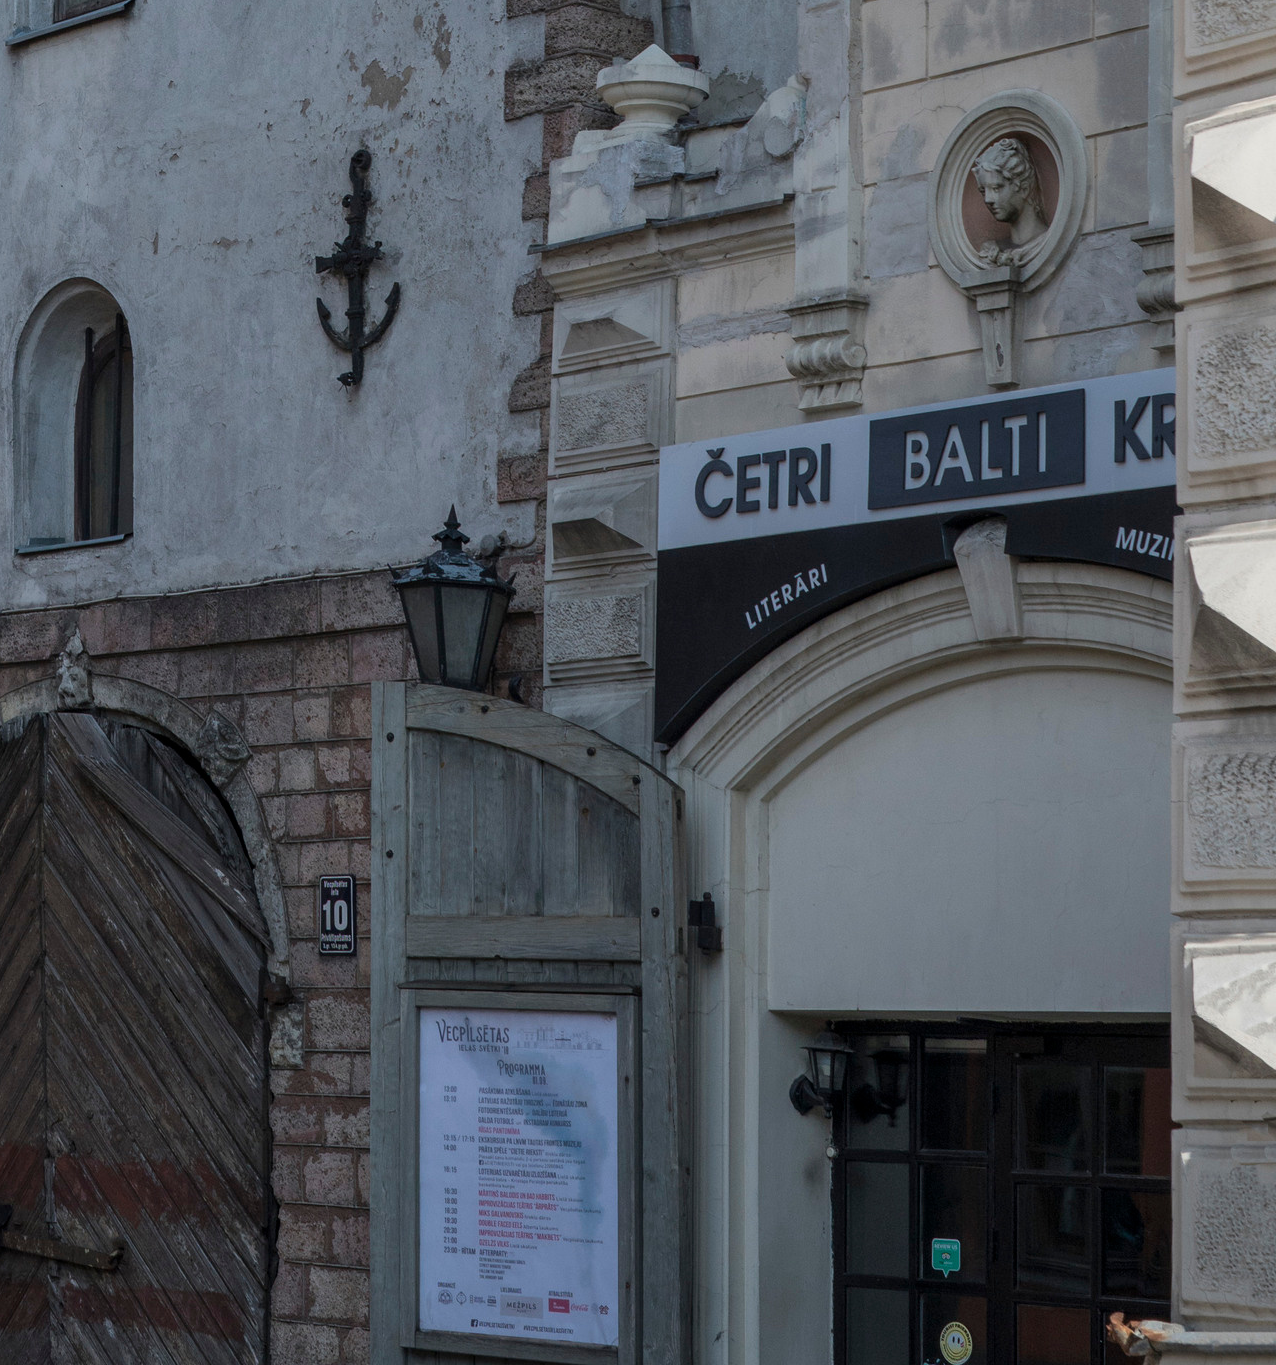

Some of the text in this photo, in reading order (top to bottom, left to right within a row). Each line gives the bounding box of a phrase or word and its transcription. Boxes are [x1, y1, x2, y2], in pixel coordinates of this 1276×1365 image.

[694, 443, 831, 519] ČETRI
[904, 411, 1048, 491] BALTI
[744, 563, 829, 630] LITERĀRI
[322, 899, 348, 931] 10
[458, 1045, 476, 1053] IELAS
[478, 1045, 500, 1053] SVĒTKI
[444, 1085, 457, 1093] 13:00
[444, 1095, 456, 1103] 13:10
[494, 1117, 514, 1125] FUTBOLS
[506, 1301, 537, 1310] MEŽPILS
